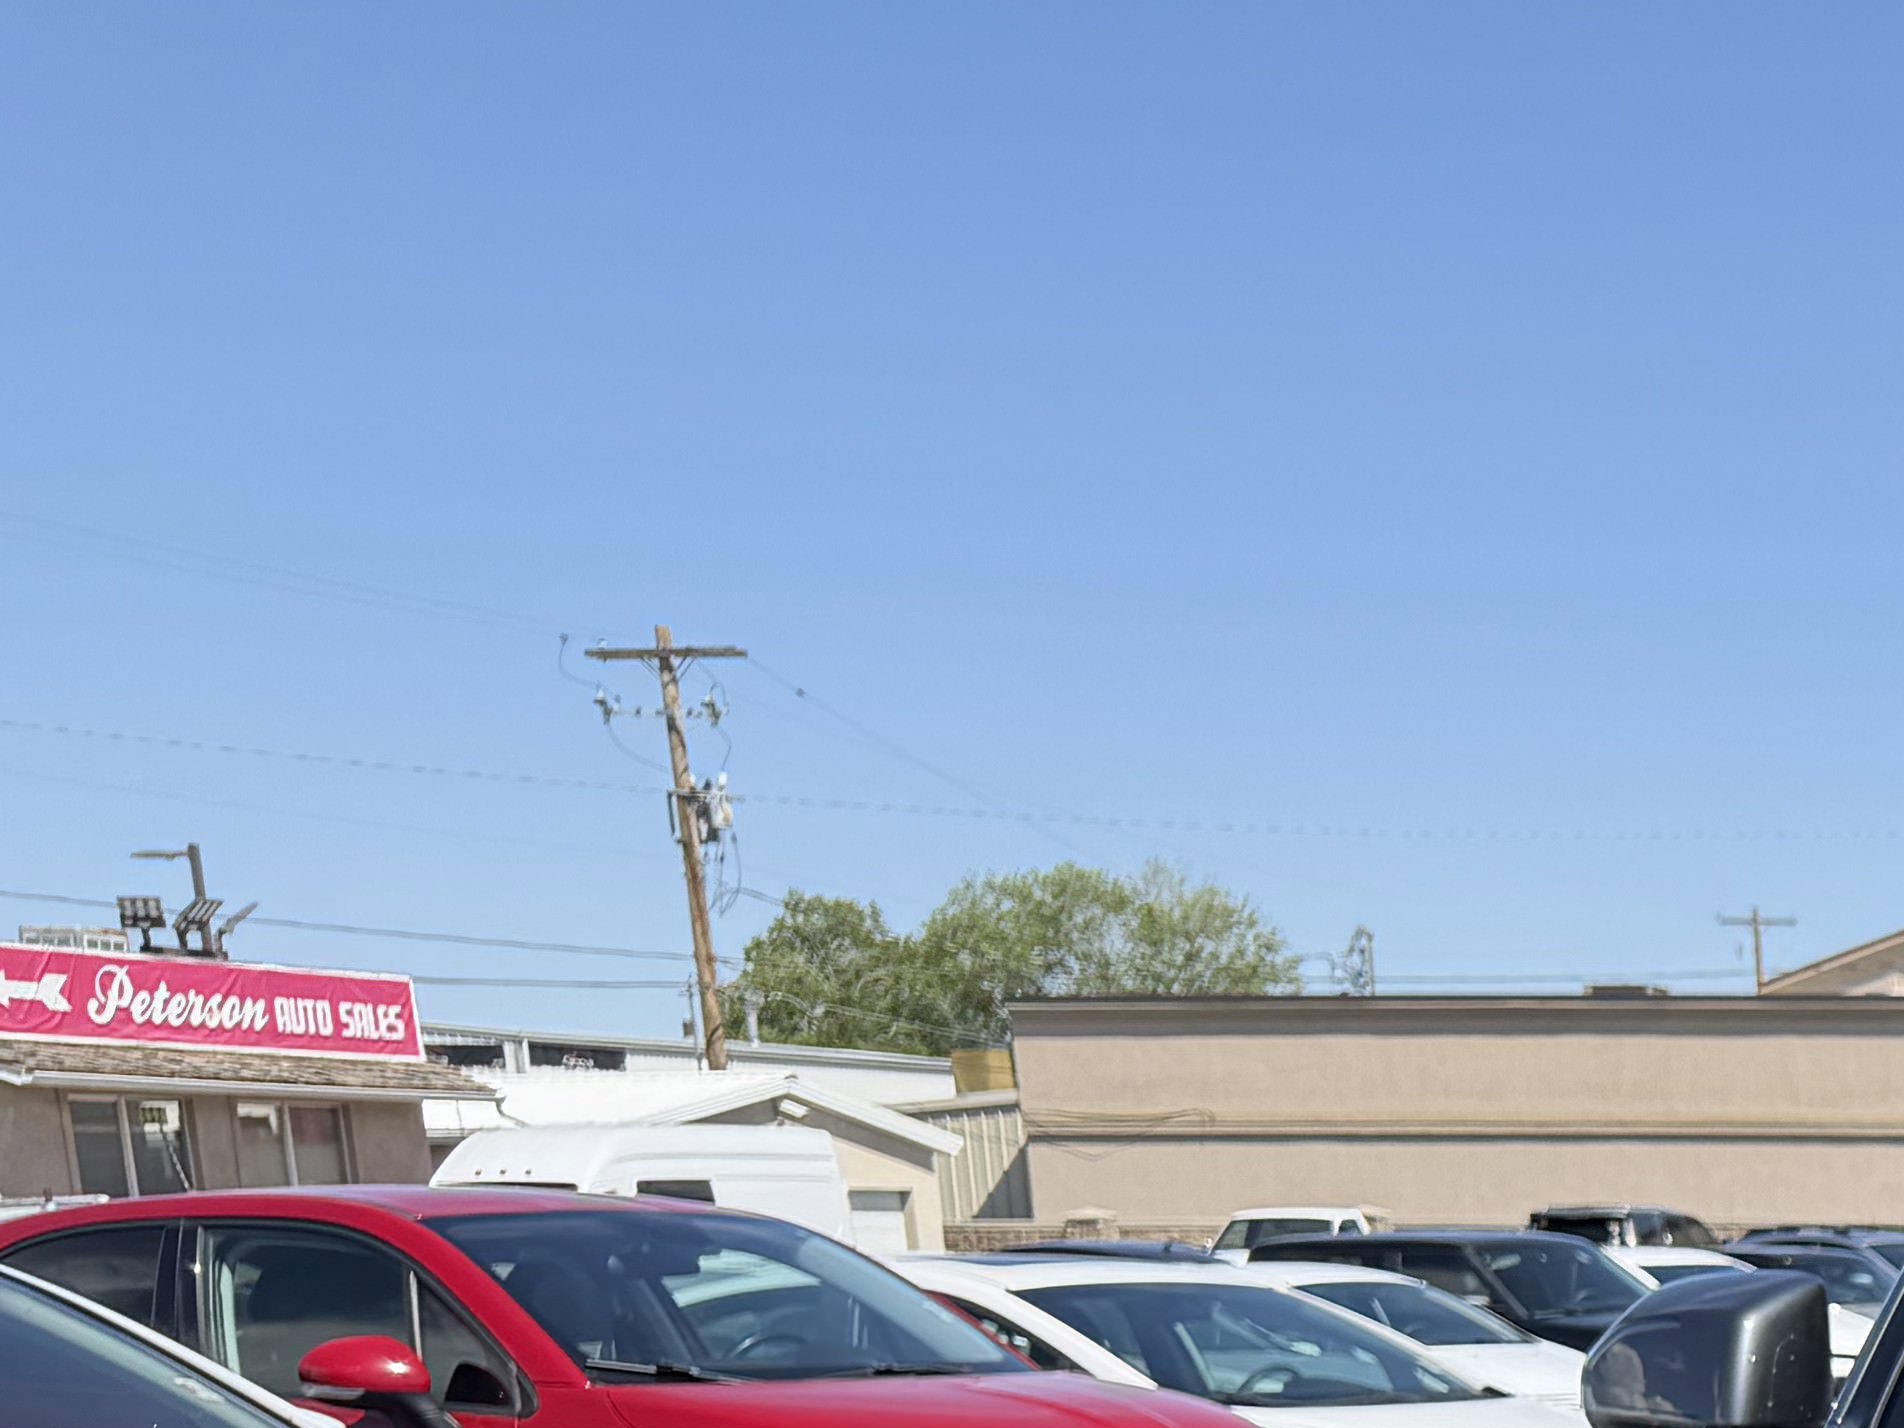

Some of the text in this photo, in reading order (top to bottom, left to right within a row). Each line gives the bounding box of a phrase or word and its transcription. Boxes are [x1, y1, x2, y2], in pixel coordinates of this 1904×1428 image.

[87, 964, 405, 1041] Peterson AUTO SALES
